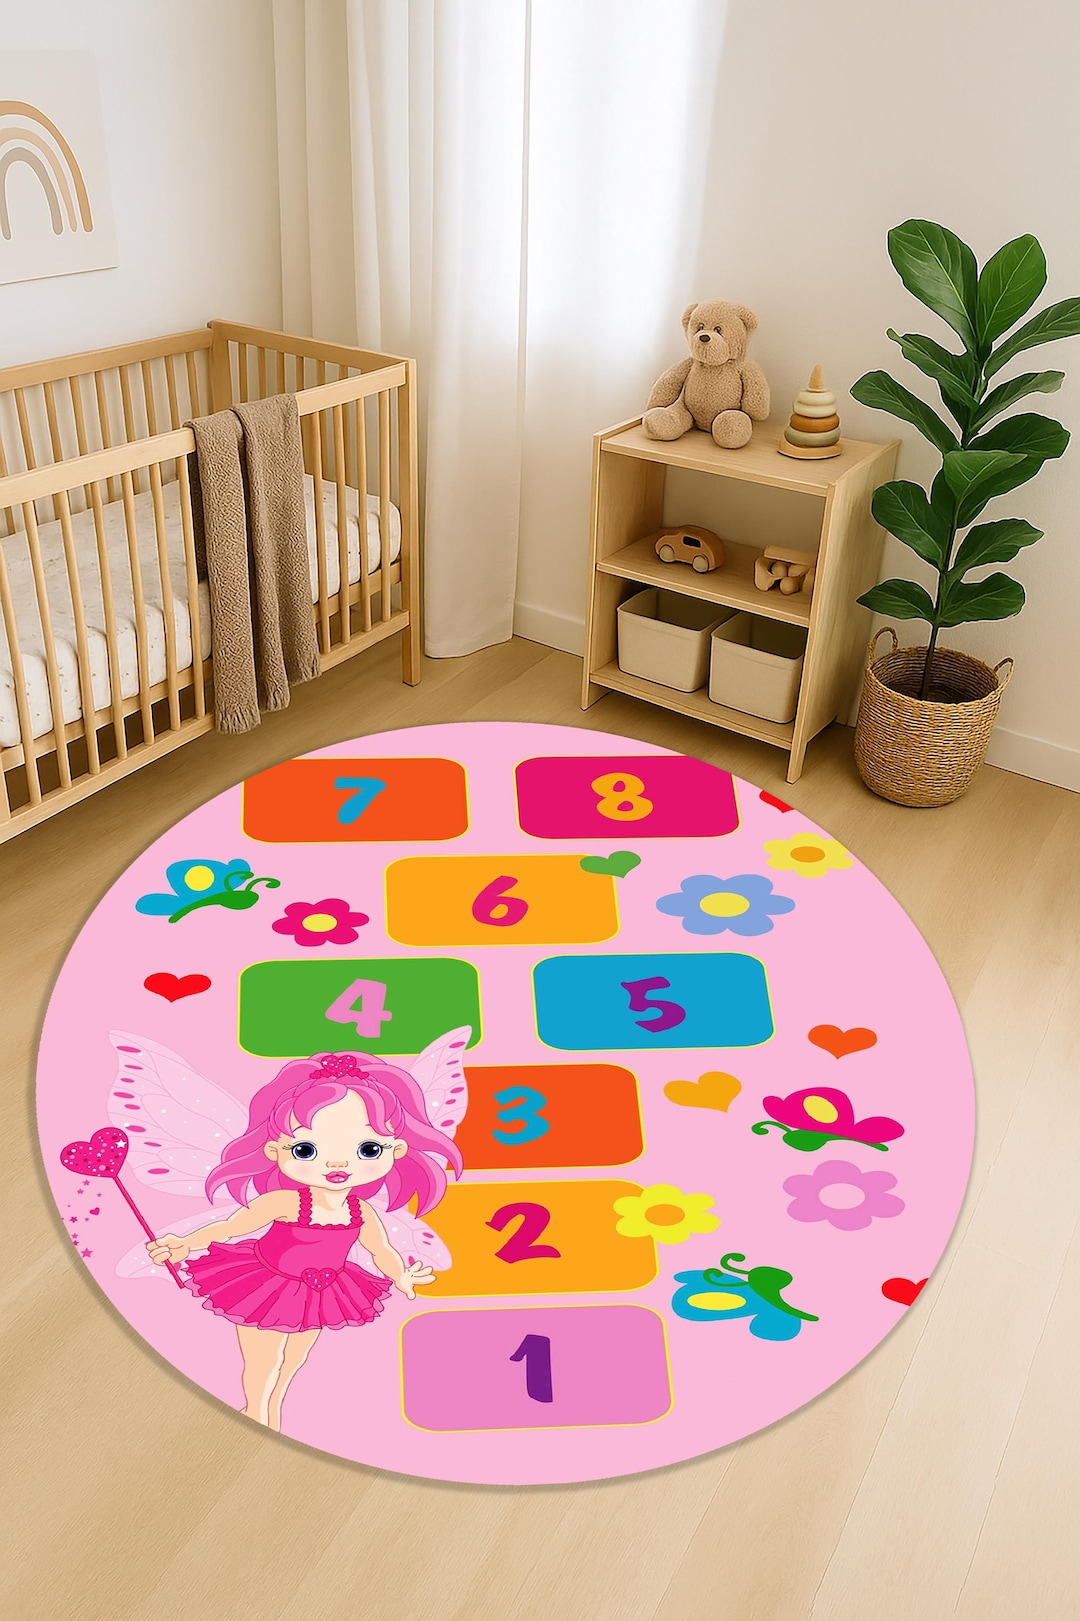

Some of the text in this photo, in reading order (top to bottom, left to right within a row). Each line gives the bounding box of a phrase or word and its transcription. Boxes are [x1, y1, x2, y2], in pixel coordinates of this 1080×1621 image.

[334, 776, 387, 825] 7
[591, 772, 654, 822] 8
[472, 875, 529, 927] 6
[325, 978, 393, 1038] 4
[620, 976, 686, 1033] 5
[491, 1085, 551, 1146] 3
[485, 1202, 561, 1264] 2
[509, 1334, 553, 1403] 1
